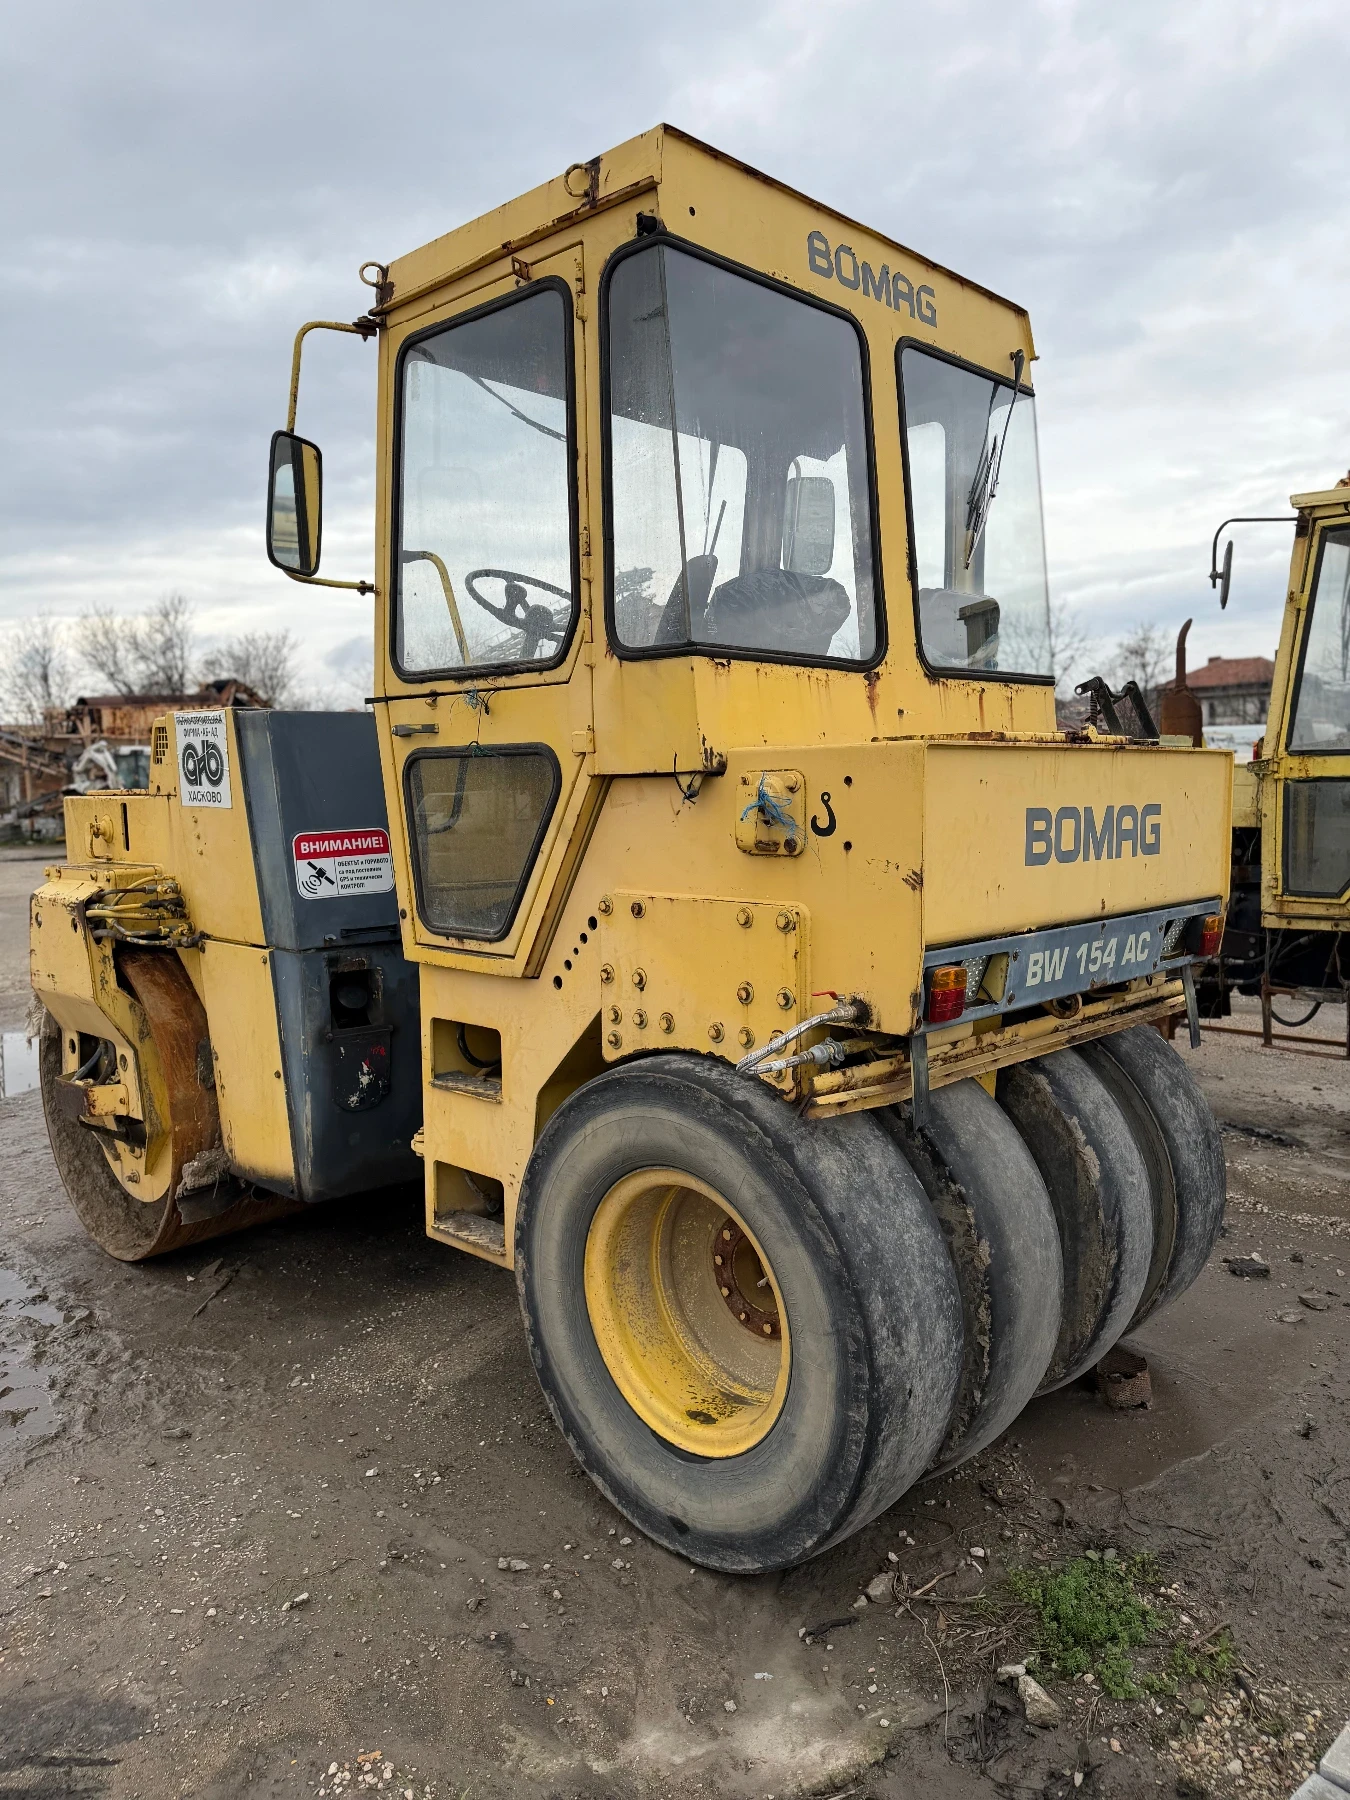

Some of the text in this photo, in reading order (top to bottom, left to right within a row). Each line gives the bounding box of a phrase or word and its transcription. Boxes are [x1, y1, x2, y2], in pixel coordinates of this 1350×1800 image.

[807, 230, 937, 328] BOMAG
[188, 791, 222, 803] ХАСКОВО
[300, 836, 384, 854] ВНИМАНИЕ!
[1024, 803, 1162, 866] BOMAG
[1026, 931, 1151, 987] BW 154 AC
